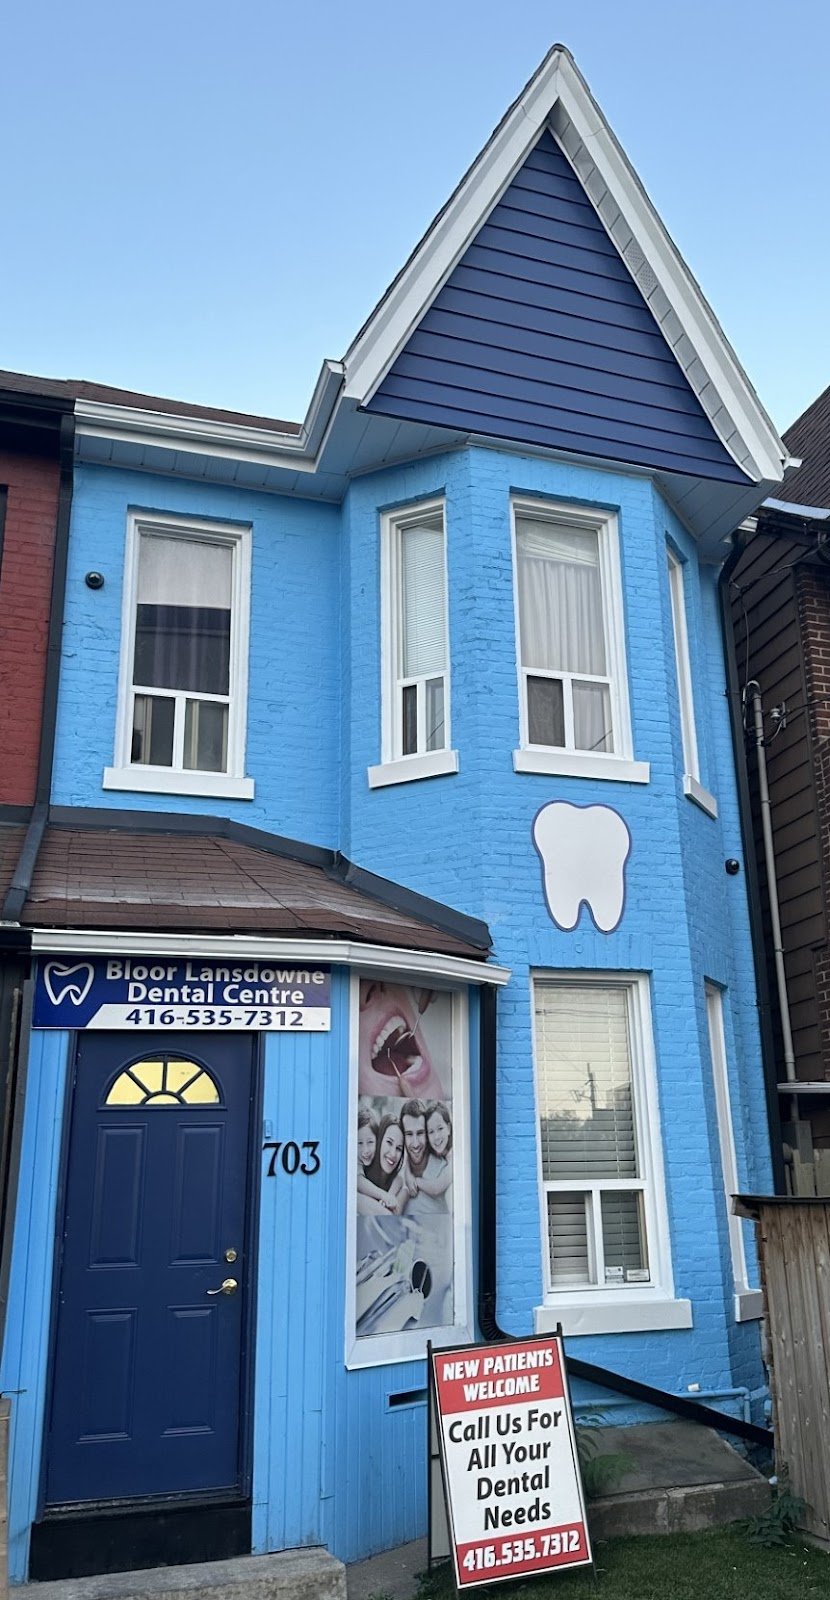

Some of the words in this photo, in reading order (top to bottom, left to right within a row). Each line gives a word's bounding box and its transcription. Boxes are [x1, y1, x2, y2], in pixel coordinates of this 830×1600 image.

[106, 960, 177, 982] Bloor
[186, 962, 325, 985] Lansdowne
[128, 982, 213, 1004] Dental
[223, 984, 305, 1005] Centre
[126, 1008, 304, 1027] 416-535-7312
[262, 1141, 321, 1177] 703
[443, 1359, 480, 1382] NEW
[483, 1348, 553, 1376] PATIENTS
[463, 1374, 540, 1402] WELCOME
[449, 1415, 490, 1443] Call
[496, 1413, 522, 1436] Us
[528, 1407, 562, 1432] For
[467, 1444, 496, 1472] All
[502, 1441, 551, 1465] Your
[477, 1465, 550, 1501] Dental
[484, 1497, 552, 1531] Needs
[462, 1529, 581, 1572] 416.535.7312
